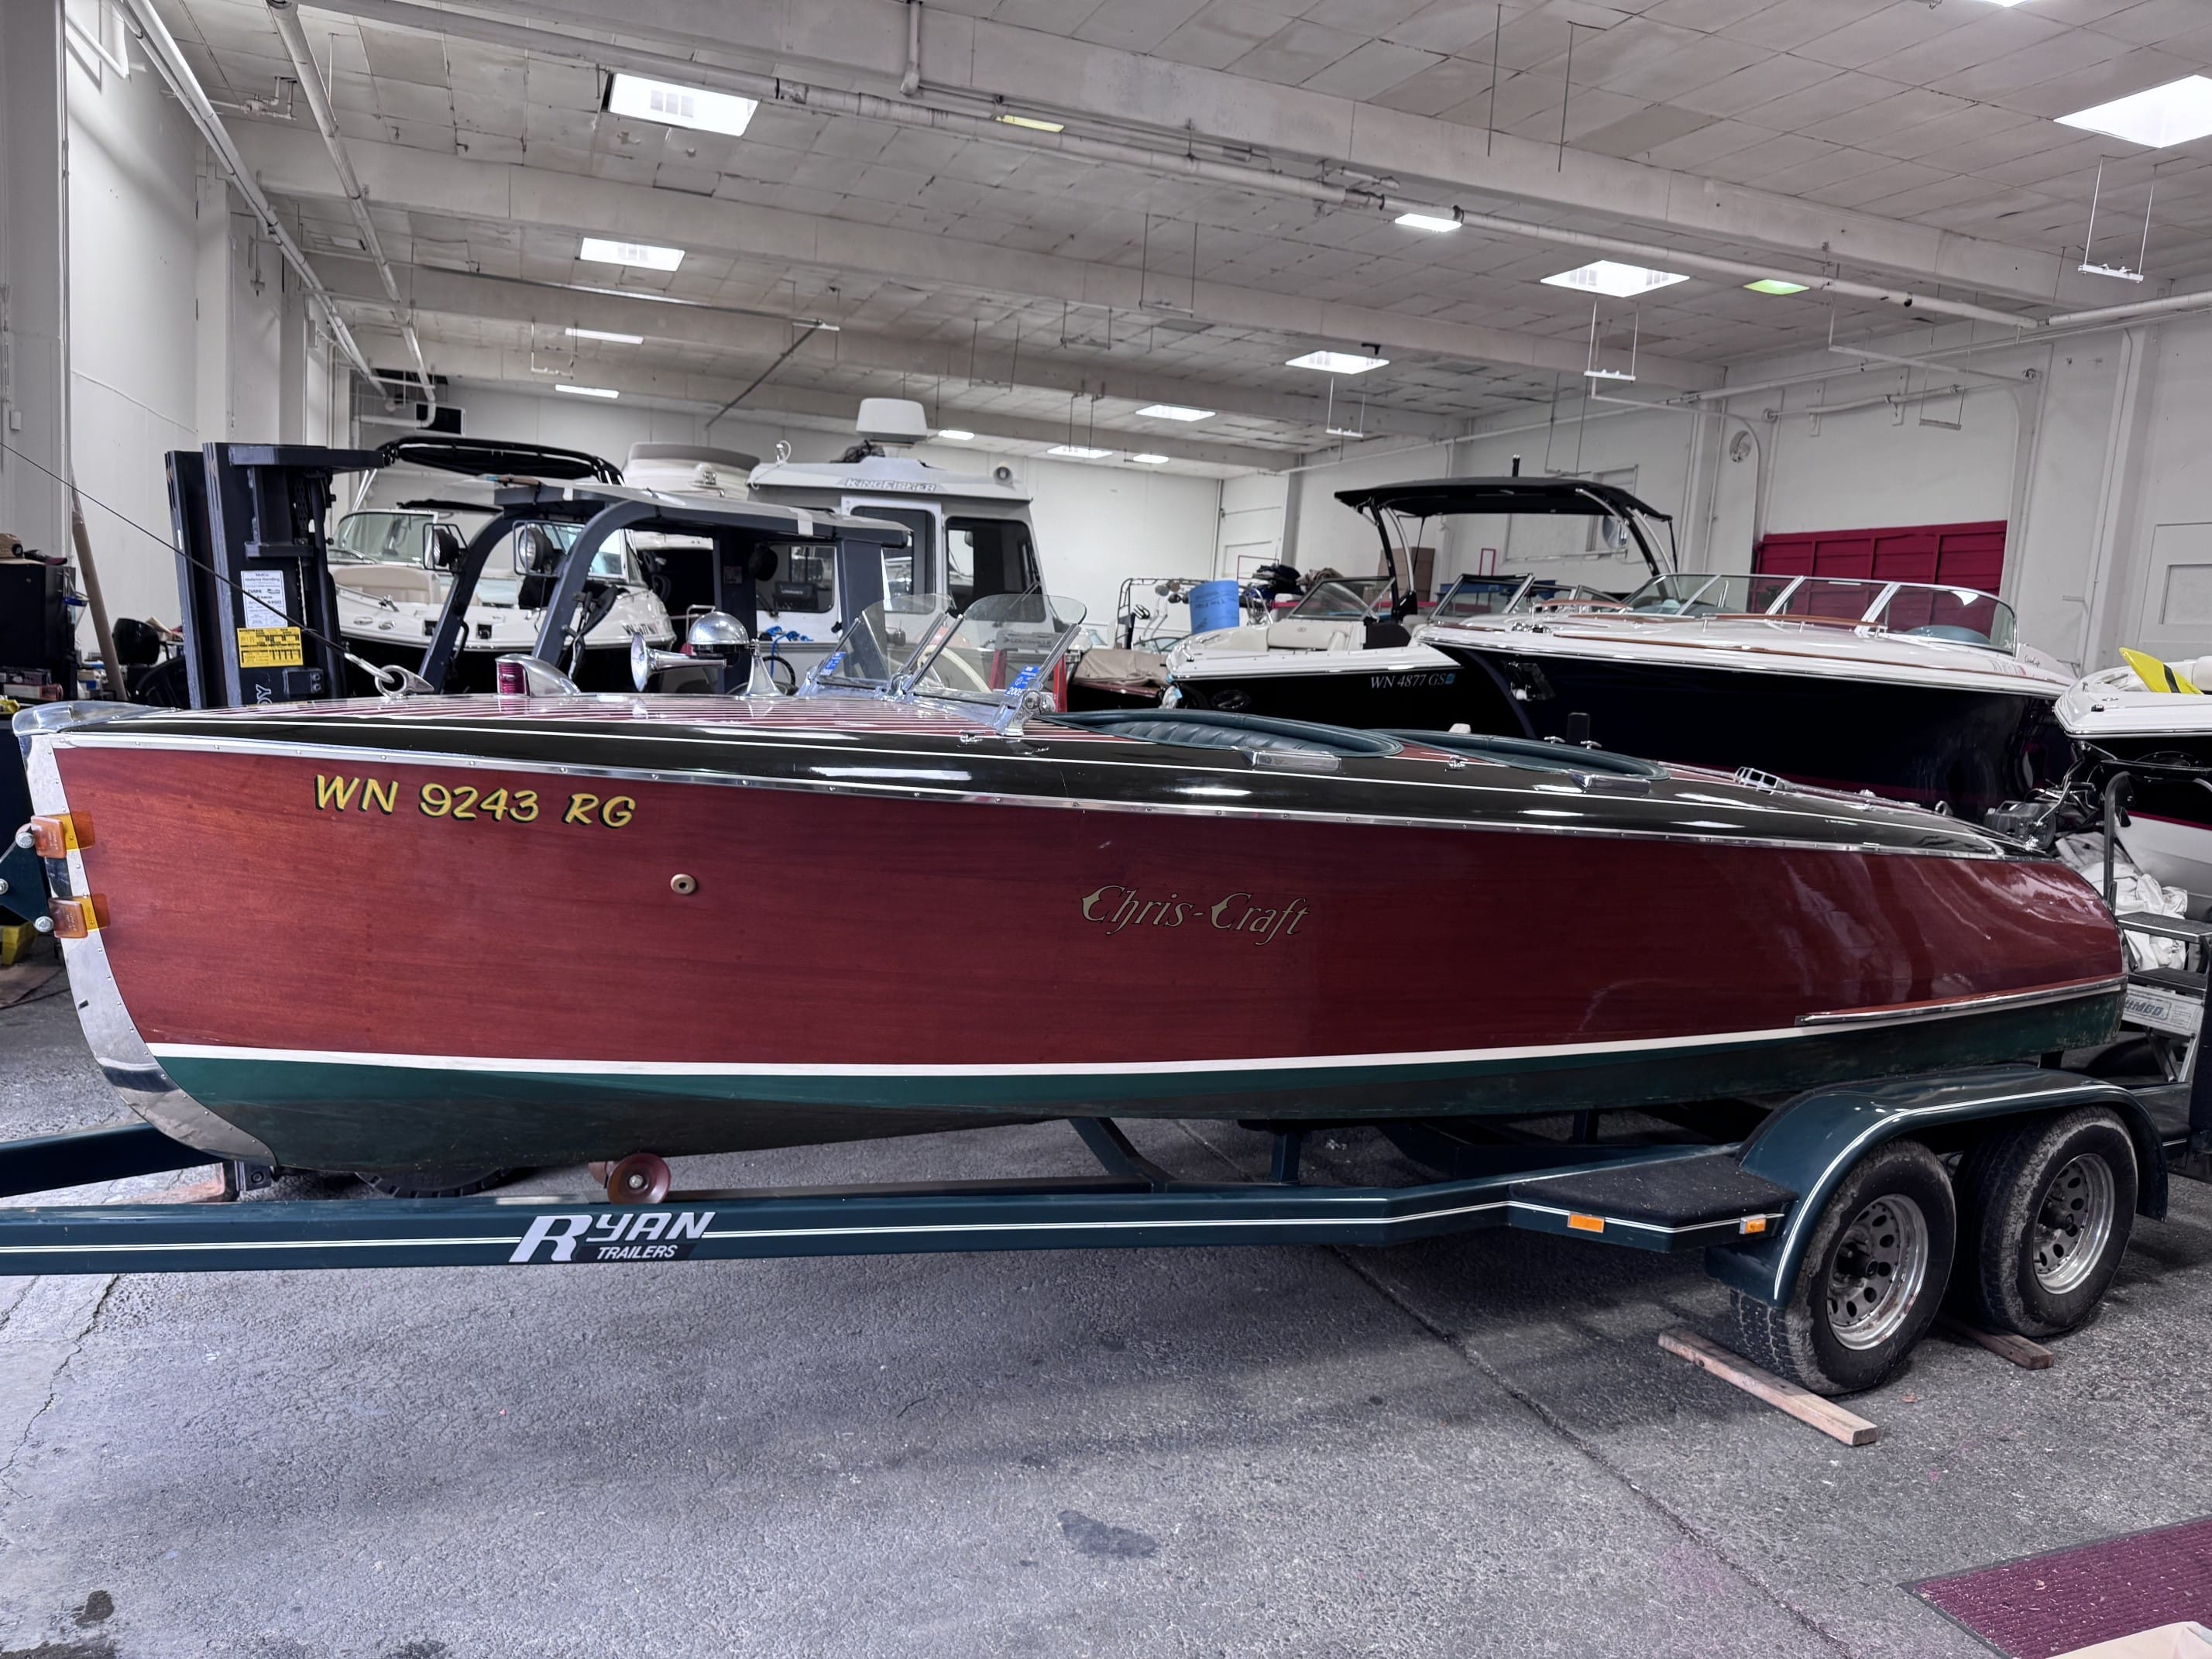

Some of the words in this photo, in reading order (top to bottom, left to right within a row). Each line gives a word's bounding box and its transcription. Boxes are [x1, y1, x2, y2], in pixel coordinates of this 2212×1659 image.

[844, 477, 936, 493] KINGFISHER
[1371, 675, 1396, 689] WN
[1396, 673, 1427, 688] 4877
[314, 774, 399, 815] WN
[418, 782, 539, 824] 9243
[562, 792, 636, 828] RG
[1081, 884, 1310, 946] Chris-Craft
[2124, 997, 2165, 1017] UMBO
[508, 1211, 716, 1263] RYAN
[596, 1245, 678, 1260] TRAILERS
